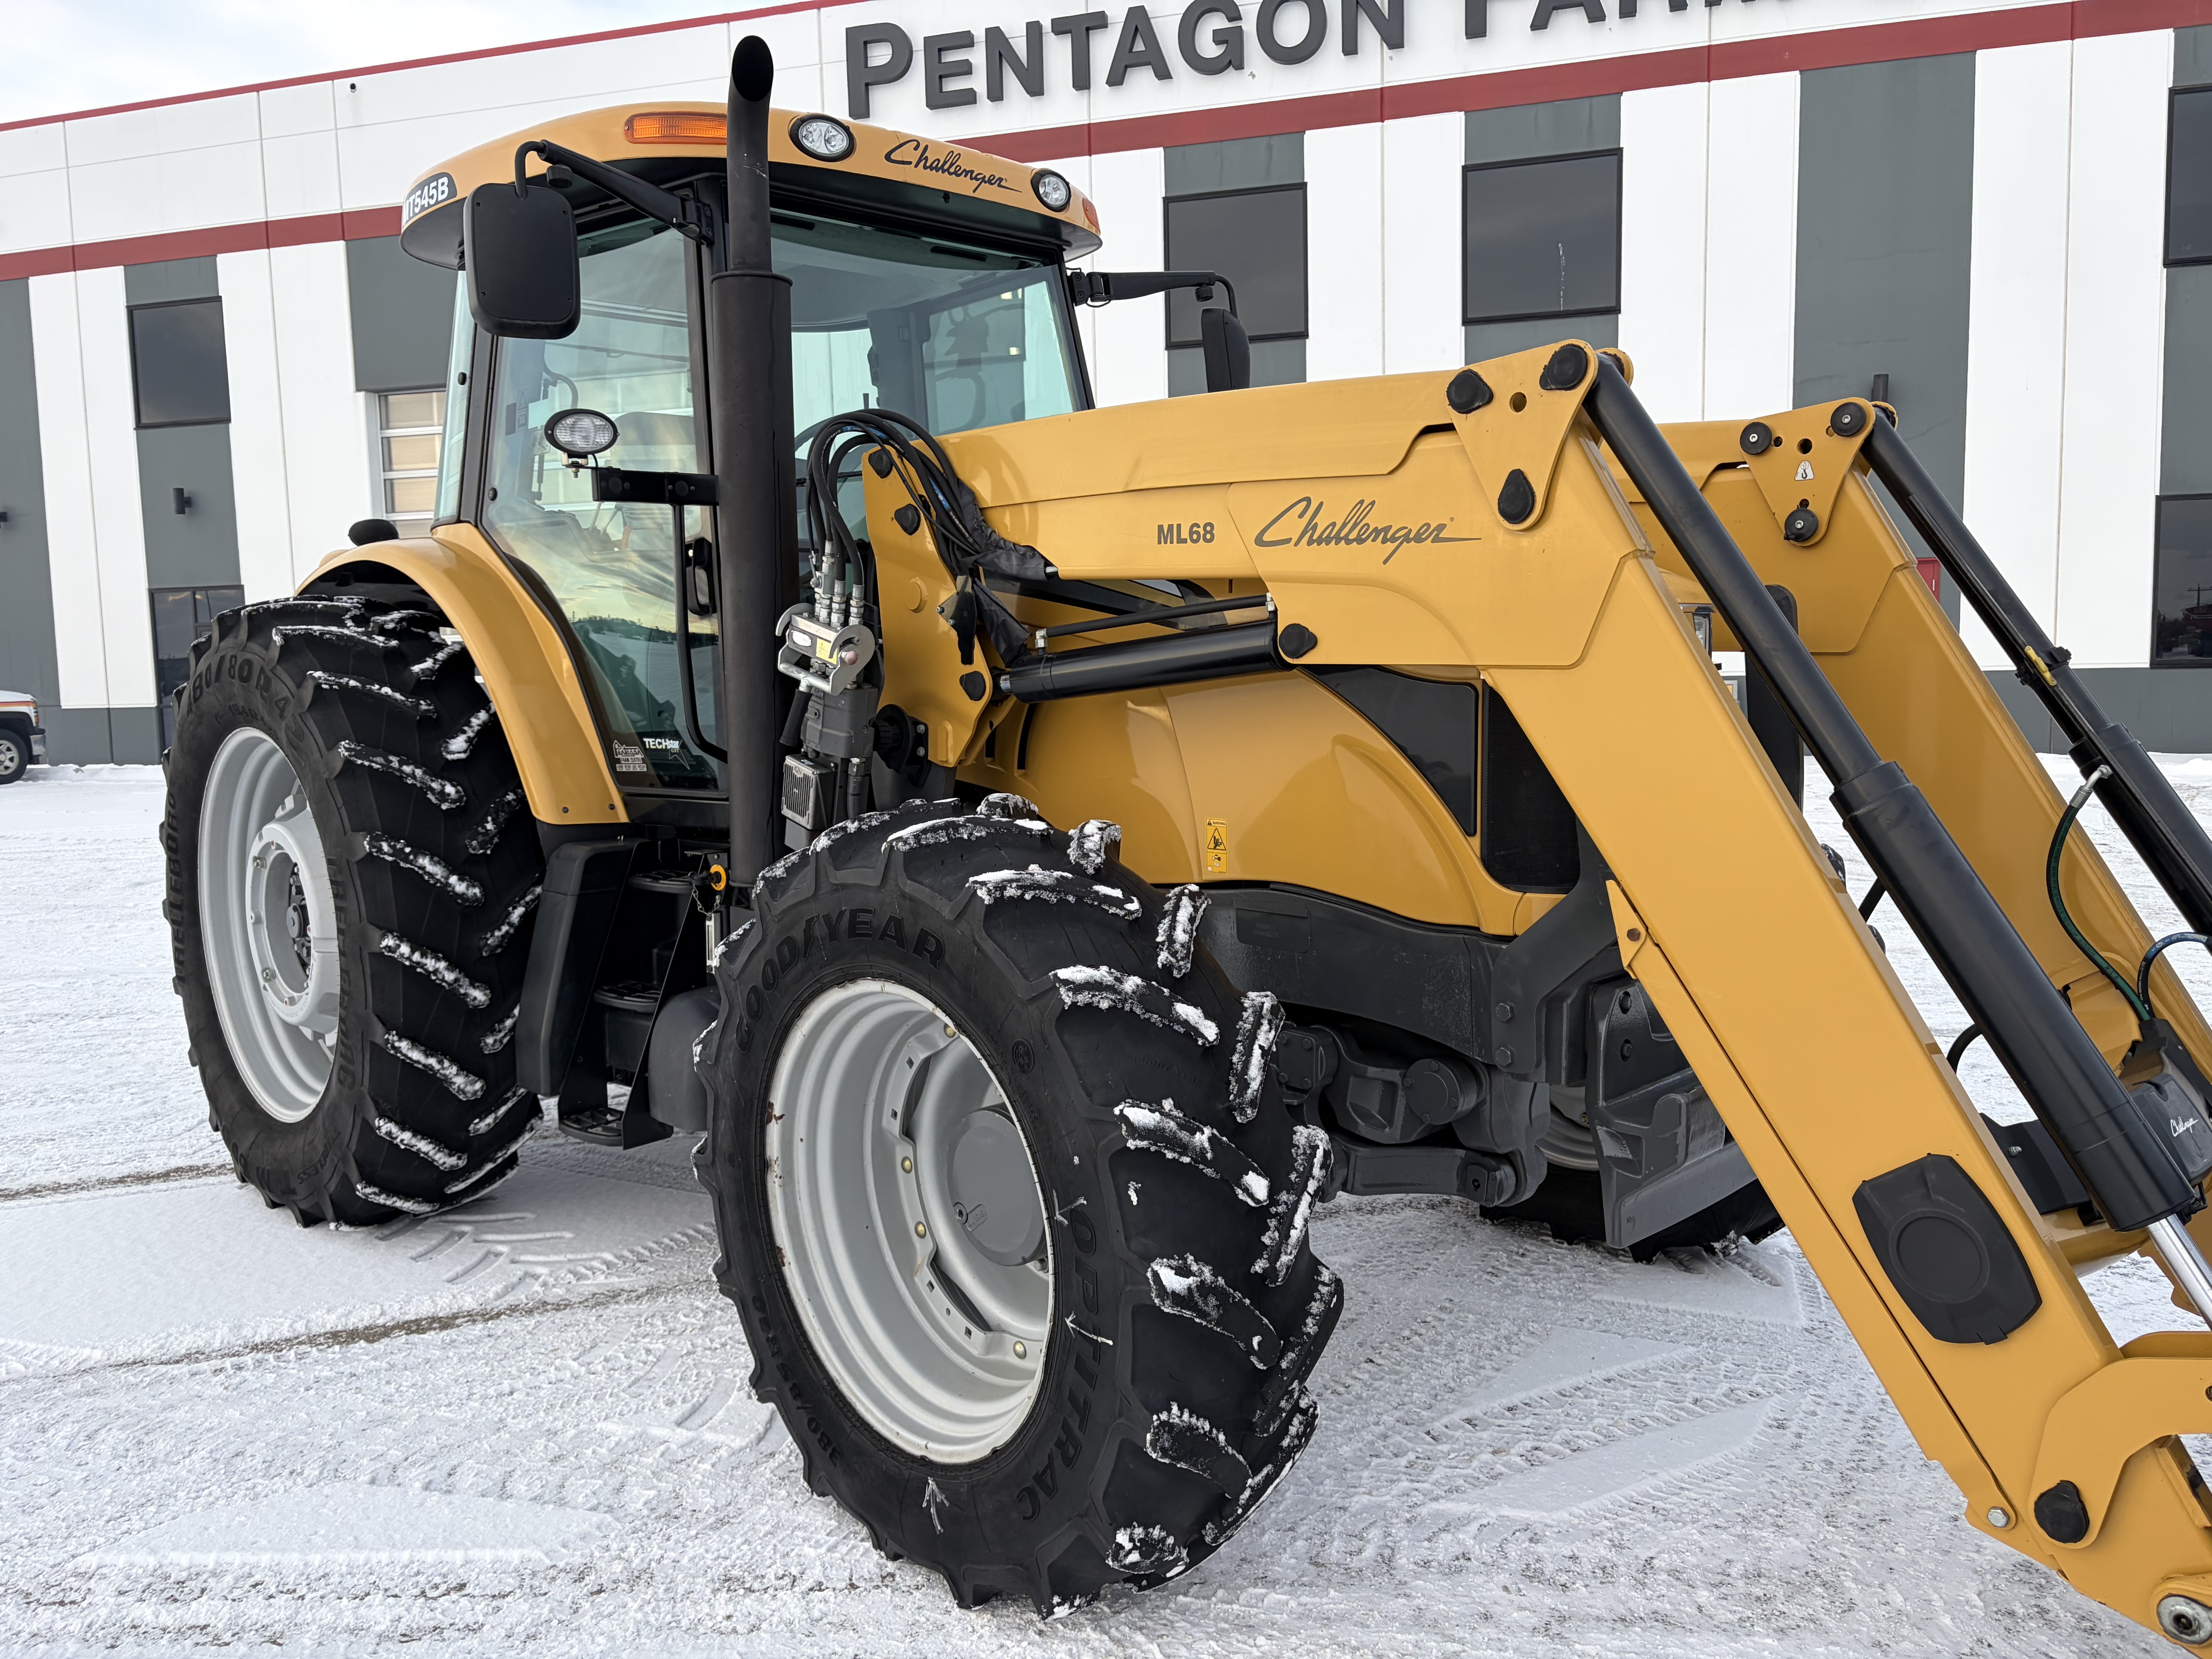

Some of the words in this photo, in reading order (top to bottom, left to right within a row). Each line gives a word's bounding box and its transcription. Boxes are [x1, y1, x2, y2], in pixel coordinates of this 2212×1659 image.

[845, 0, 1405, 120] PENTAGON
[884, 139, 1022, 194] Challenger
[1157, 522, 1215, 545] ML68
[1254, 496, 1482, 565] Challenger
[736, 907, 946, 1053] GOODYEAR
[1016, 1208, 1101, 1522] OPTITRAC
